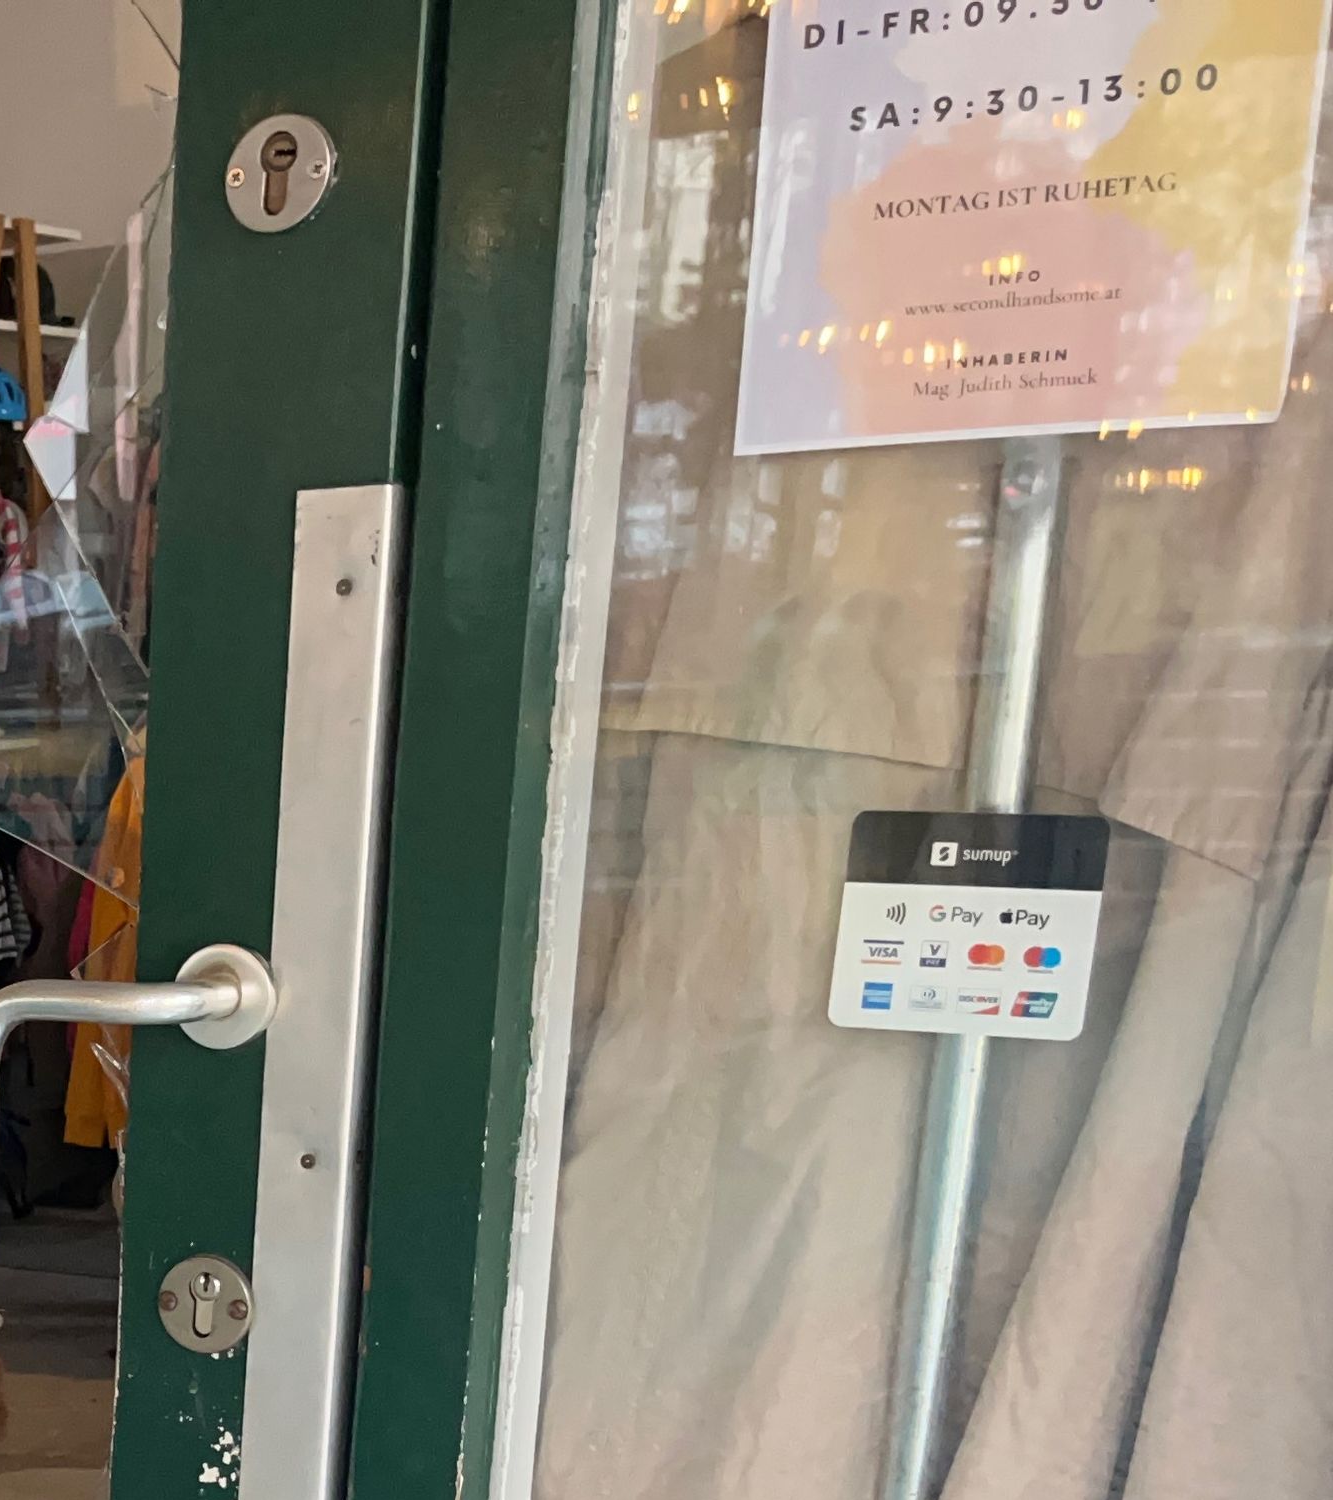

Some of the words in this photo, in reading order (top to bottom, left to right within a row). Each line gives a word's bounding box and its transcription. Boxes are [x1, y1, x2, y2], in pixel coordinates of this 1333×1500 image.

[849, 63, 1218, 132] SA:9:30-13:00
[873, 191, 989, 220] MONTAG
[997, 186, 1037, 208] IST
[1044, 172, 1177, 203] RUHETAG
[988, 270, 1041, 286] INFO
[957, 374, 1012, 399] Judith
[1019, 367, 1098, 391] Schmuck
[962, 848, 1012, 867] sumup
[950, 906, 983, 928] Pay
[1015, 909, 1050, 930] Pay
[868, 946, 899, 958] VISA
